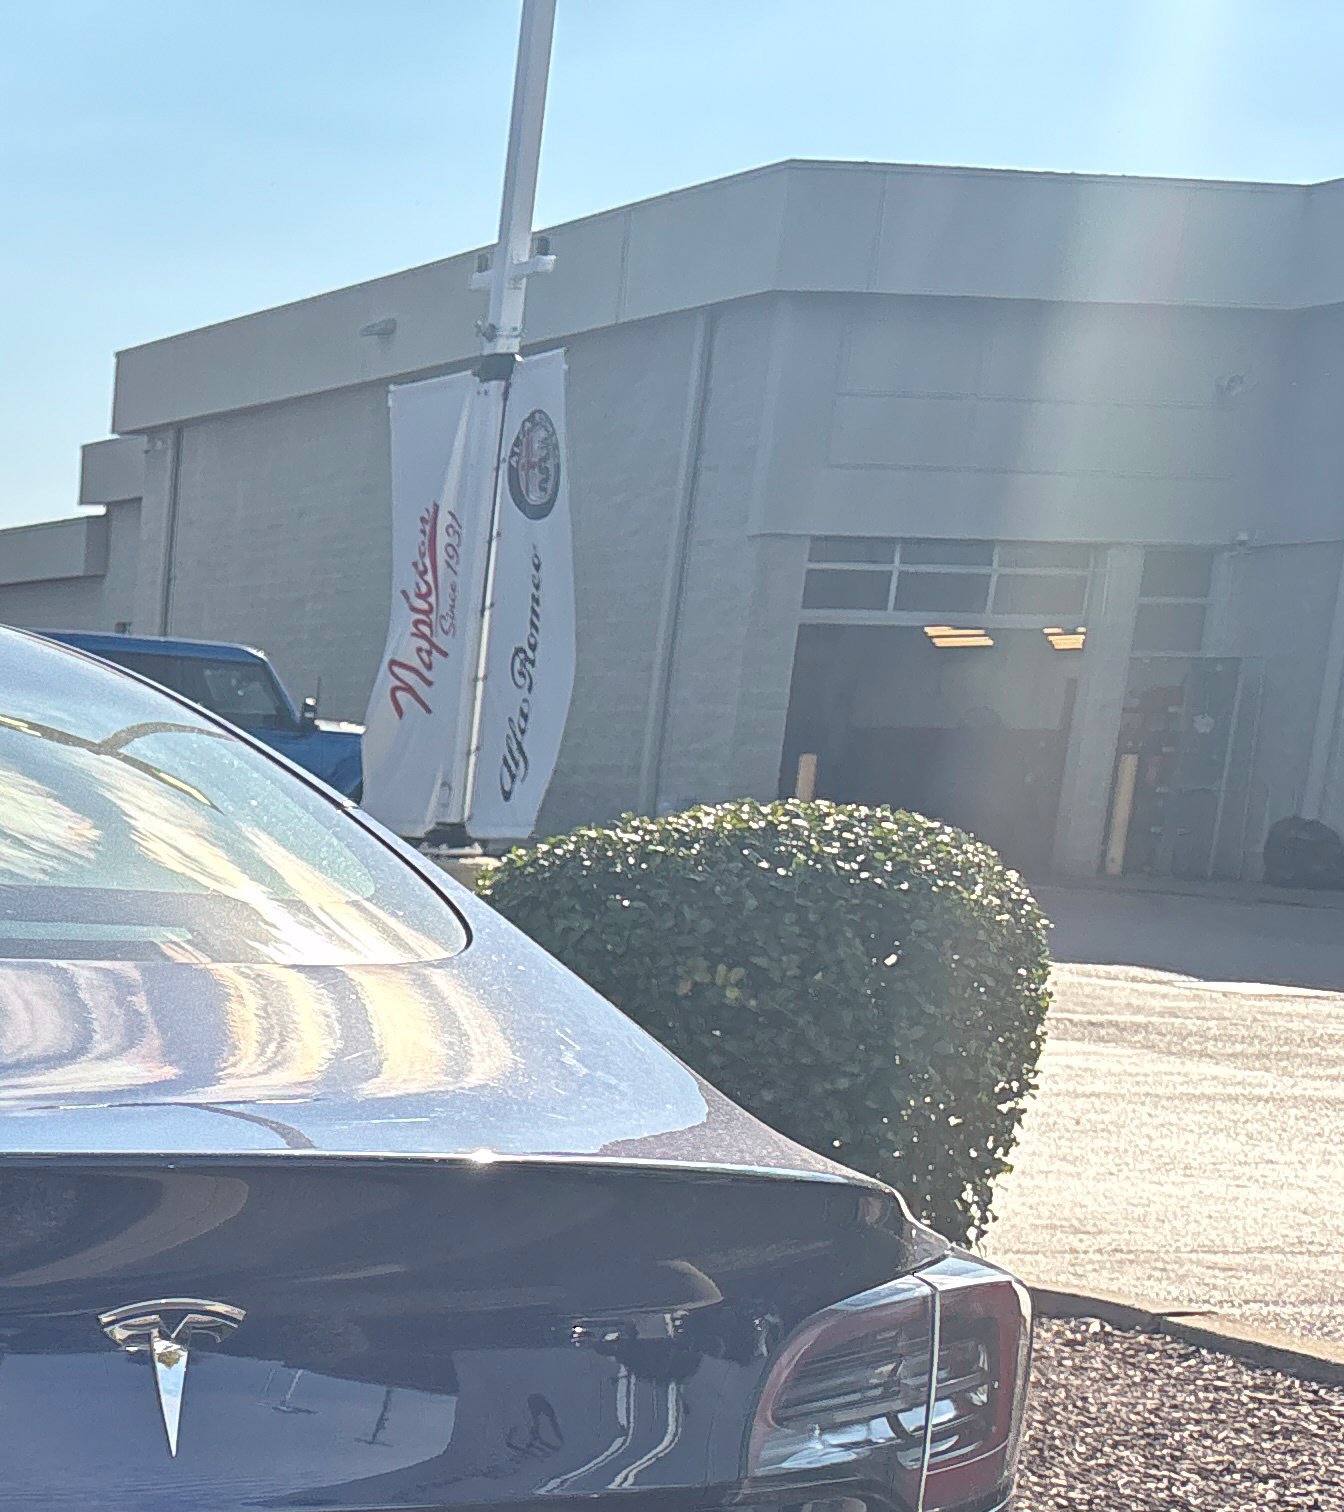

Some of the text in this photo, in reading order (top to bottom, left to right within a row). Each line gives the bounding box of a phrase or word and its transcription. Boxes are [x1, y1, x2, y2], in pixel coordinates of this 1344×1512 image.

[388, 506, 449, 720] Napleton
[444, 510, 463, 576] 1931
[499, 544, 543, 802] Alfa Romeo
